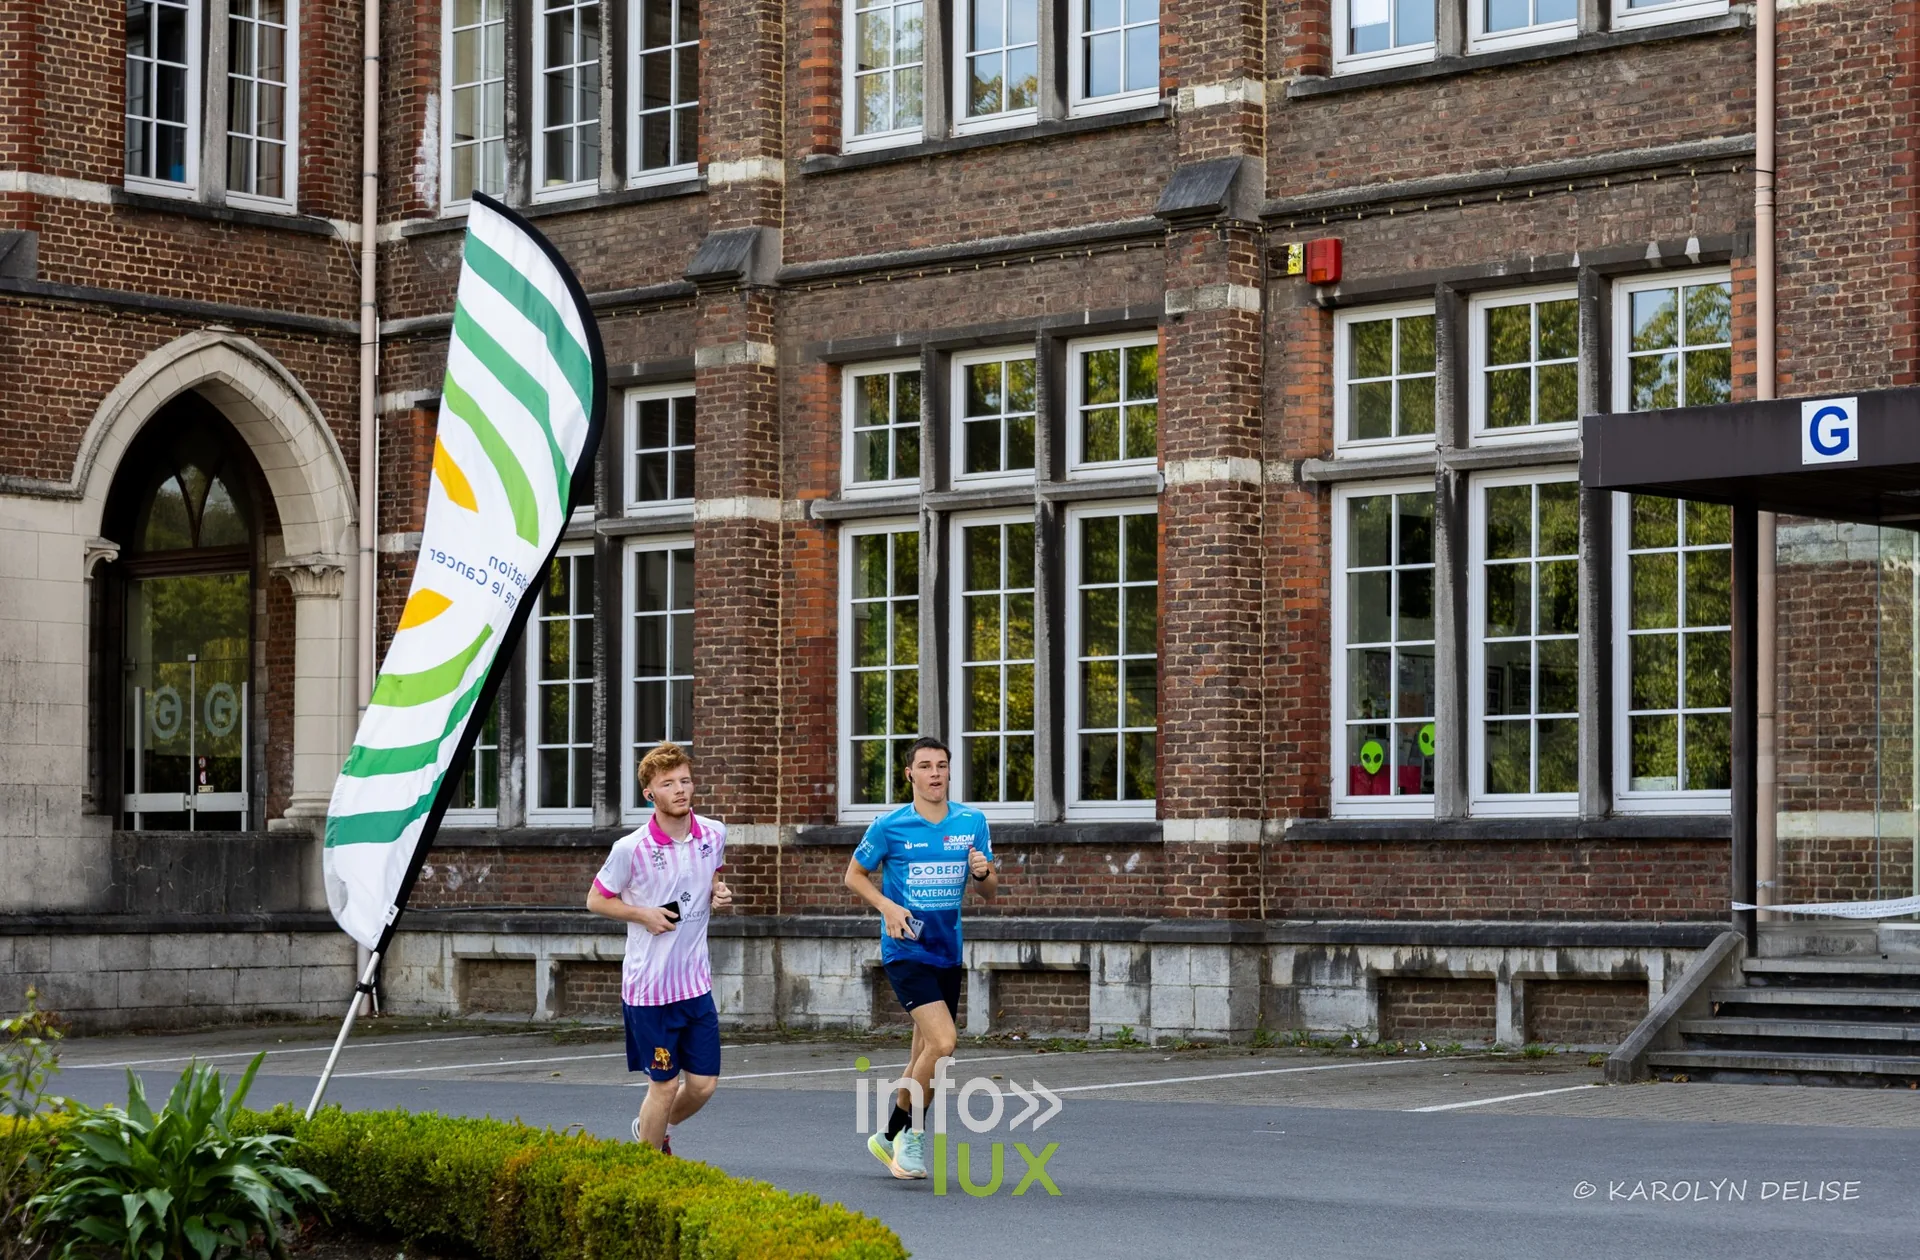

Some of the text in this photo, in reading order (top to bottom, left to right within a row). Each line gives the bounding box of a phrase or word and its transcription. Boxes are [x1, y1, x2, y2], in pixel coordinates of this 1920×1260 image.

[1809, 405, 1850, 456] G
[155, 693, 177, 731] G
[209, 690, 232, 729] G
[949, 834, 975, 843] SMDM
[911, 865, 965, 876] GOBERT
